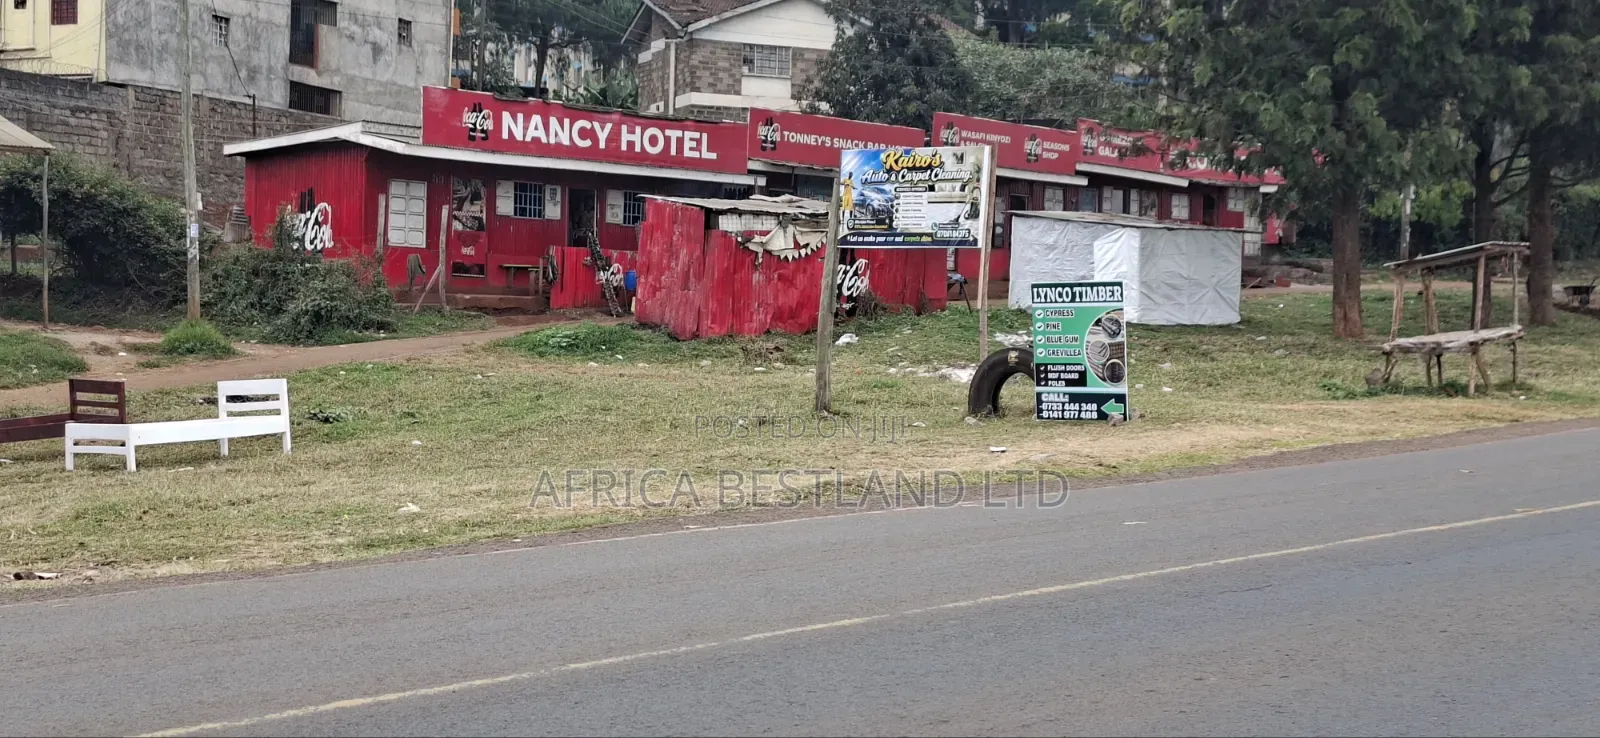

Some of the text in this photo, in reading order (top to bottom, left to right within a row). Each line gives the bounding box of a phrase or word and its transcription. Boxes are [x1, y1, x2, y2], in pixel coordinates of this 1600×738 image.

[502, 111, 717, 160] NANCY HOTEL
[783, 130, 832, 148] TONNEY'S
[833, 137, 866, 150] SNACK
[1042, 141, 1070, 152] SEASONS
[883, 148, 942, 170] Kairo's
[1042, 151, 1059, 160] SHOP
[860, 169, 889, 184] Auto
[898, 168, 931, 183] Carpet
[1032, 286, 1122, 303] LYNCO TIMBER
[1045, 309, 1075, 317] CYPRESS
[1045, 322, 1061, 331] PINE
[1046, 335, 1079, 343] BLUE GUM
[1047, 348, 1082, 357] GREVILLEA
[1041, 393, 1069, 402] CALL:
[1063, 403, 1079, 411] 444
[1063, 411, 1079, 419] 977
